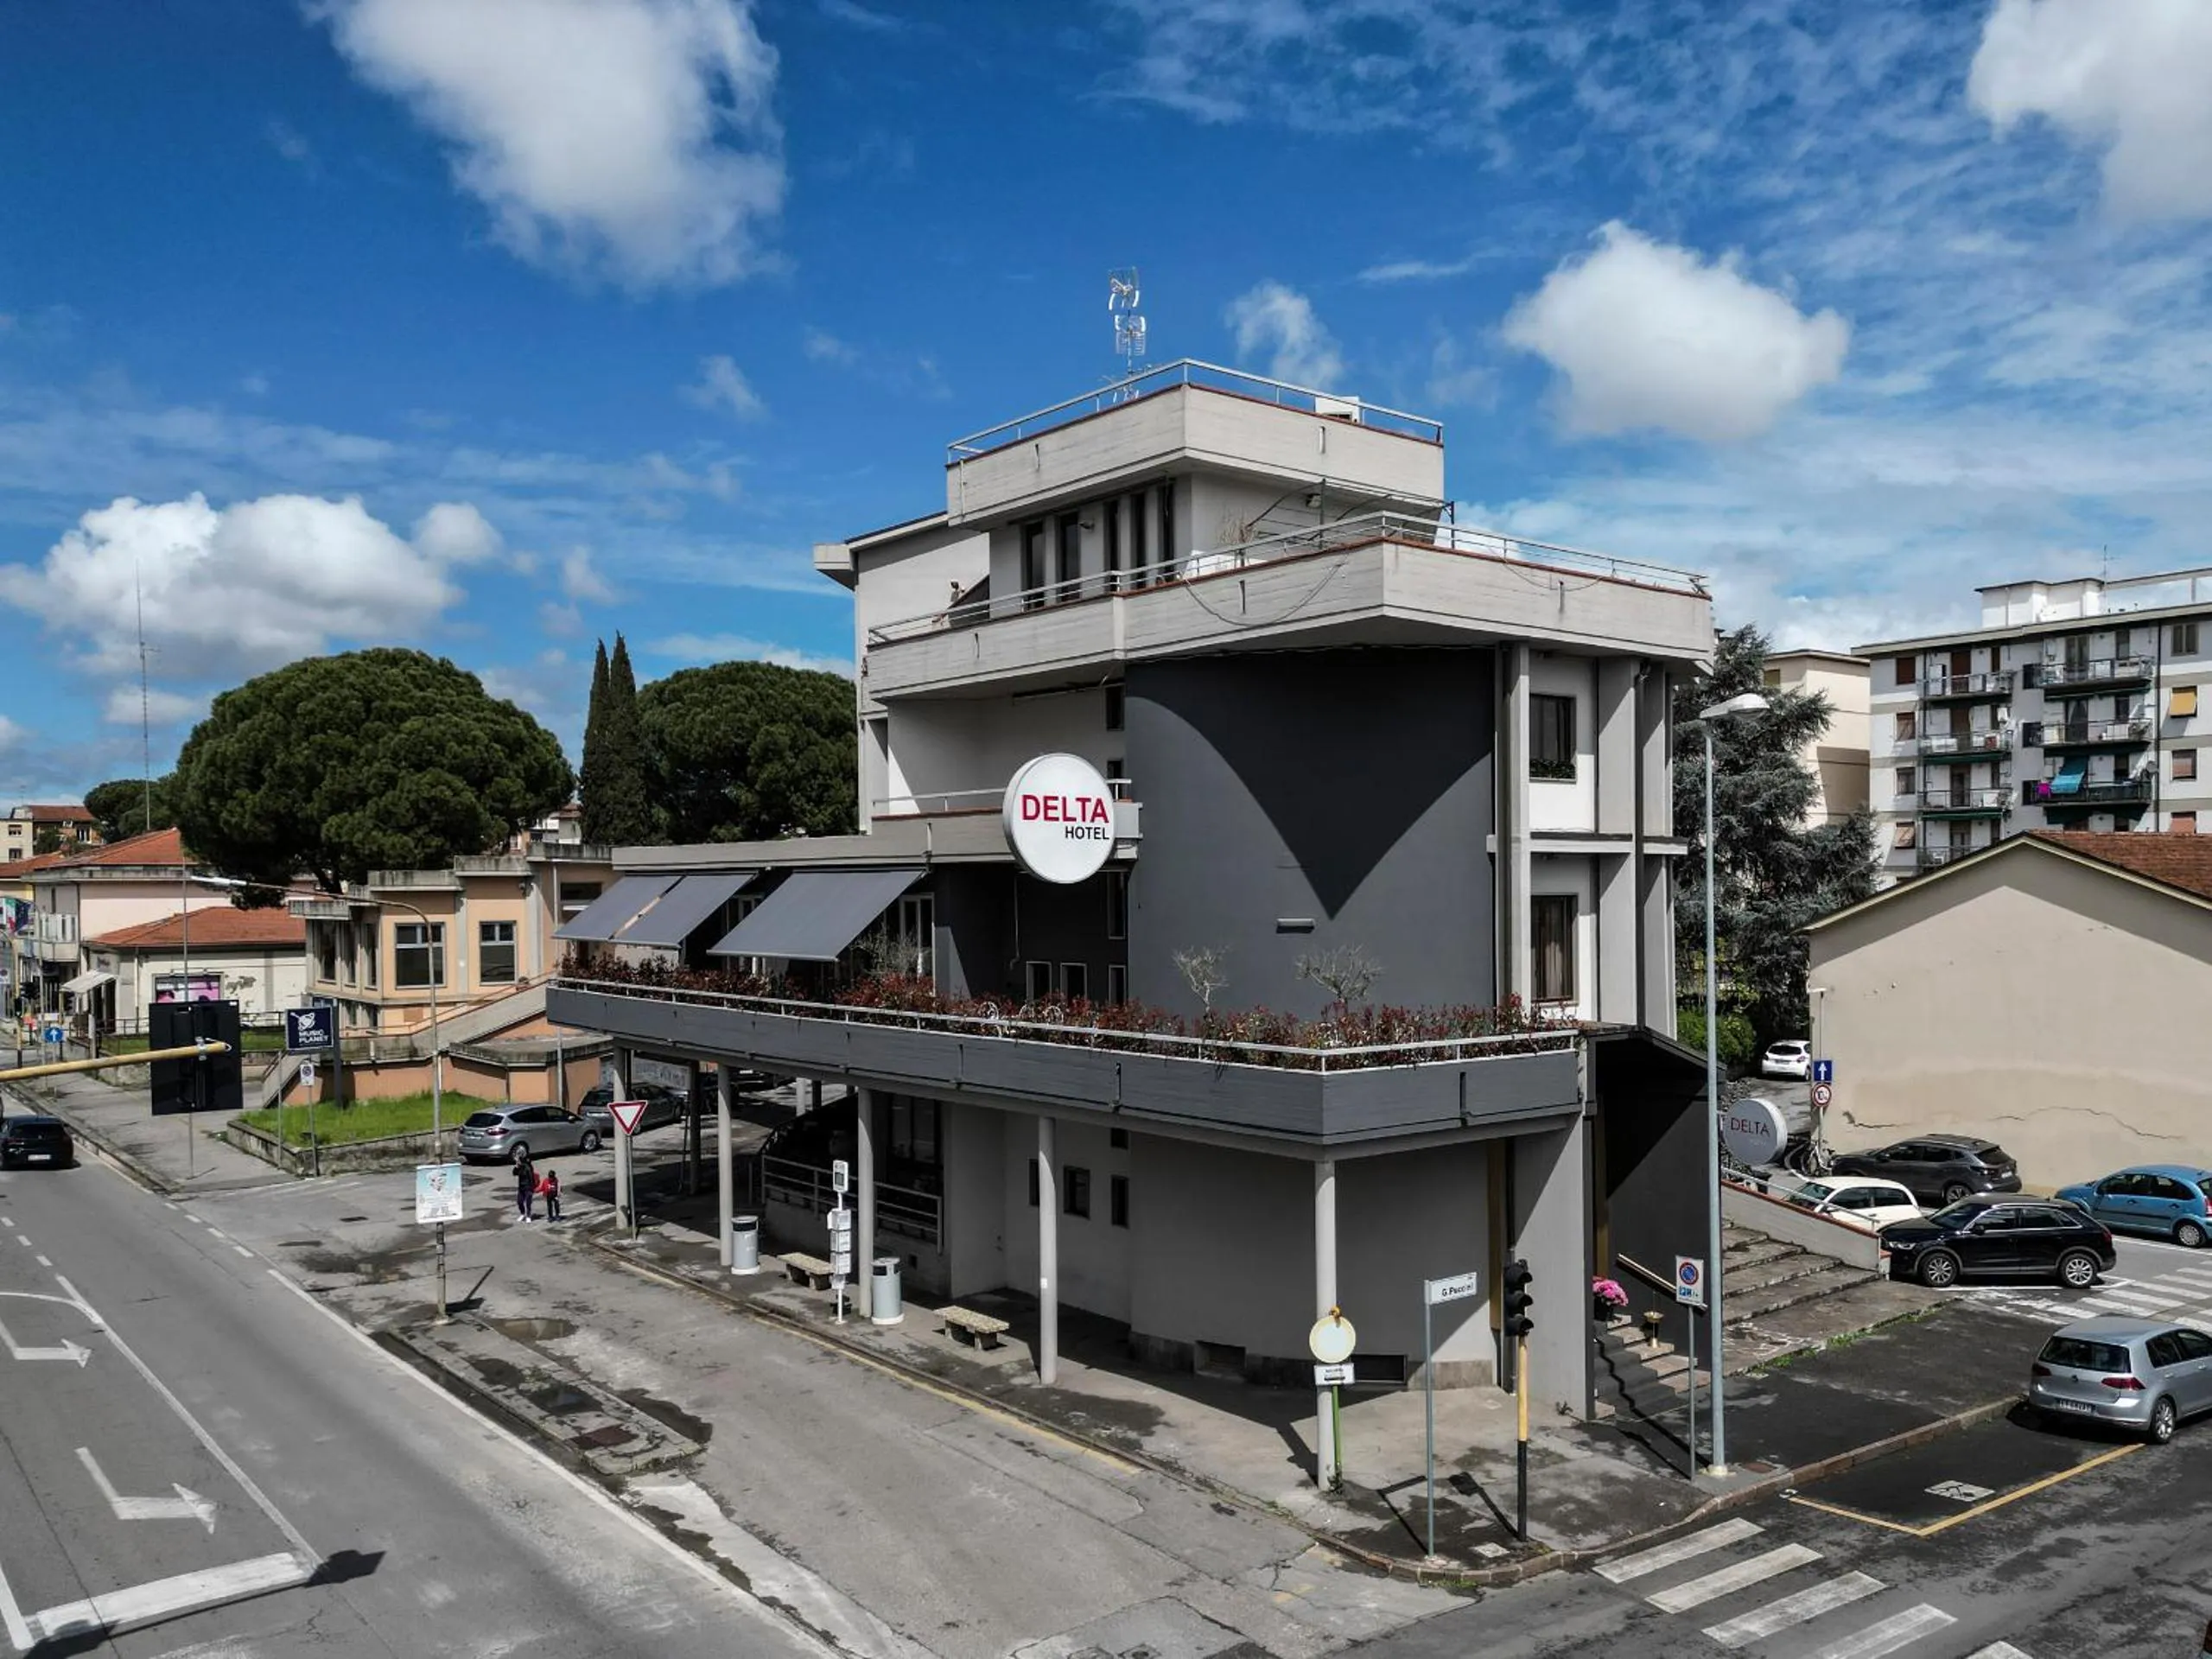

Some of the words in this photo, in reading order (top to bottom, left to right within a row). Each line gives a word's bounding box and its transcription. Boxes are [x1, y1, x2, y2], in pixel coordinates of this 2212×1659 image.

[1021, 794, 1109, 823] DELTA
[1065, 826, 1109, 840] HOTEL
[298, 1035, 328, 1044] PLANET
[1730, 1117, 1770, 1137] DELTA
